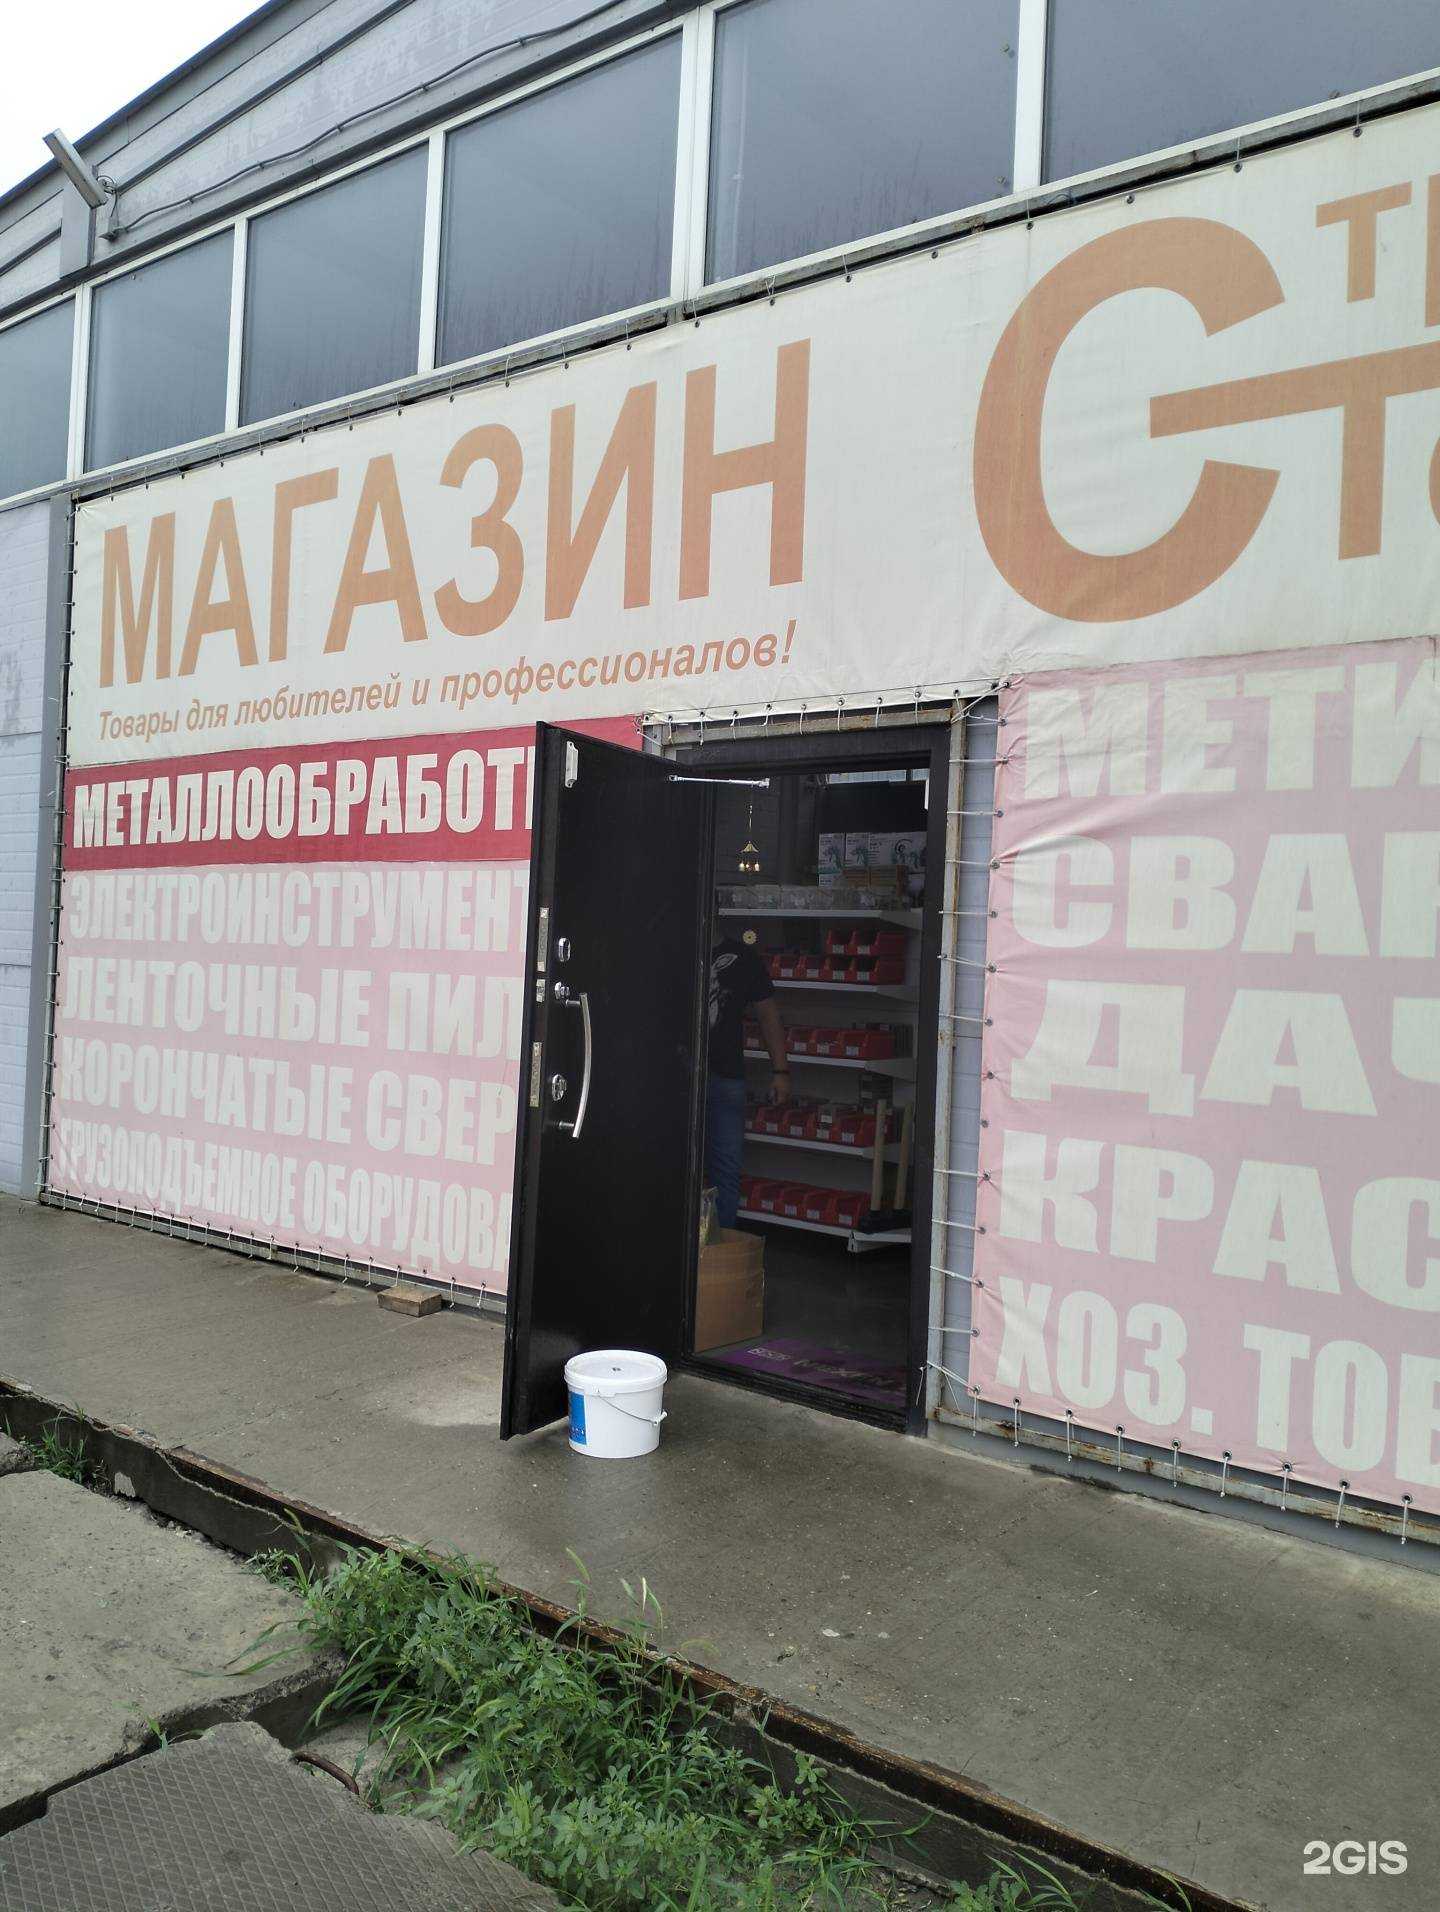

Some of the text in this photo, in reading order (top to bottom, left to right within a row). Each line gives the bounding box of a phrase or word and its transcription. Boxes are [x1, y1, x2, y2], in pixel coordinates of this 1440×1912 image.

[1316, 173, 1440, 328] Т
[99, 338, 811, 689] МАГАЗИН
[100, 619, 797, 743] Товары для любителей и профессионалов!
[73, 746, 534, 849] МЕТАЛЛООБРАБОТ
[62, 956, 525, 1060] ЛЕНТОЧНЫЕ ПИЛ
[61, 1036, 517, 1166] КОРОНЧАТЫЕ СВЕР
[59, 1118, 297, 1229] ГРУЗОПОДЪЕМНОЕ
[995, 1275, 1214, 1436] ХОЗ.
